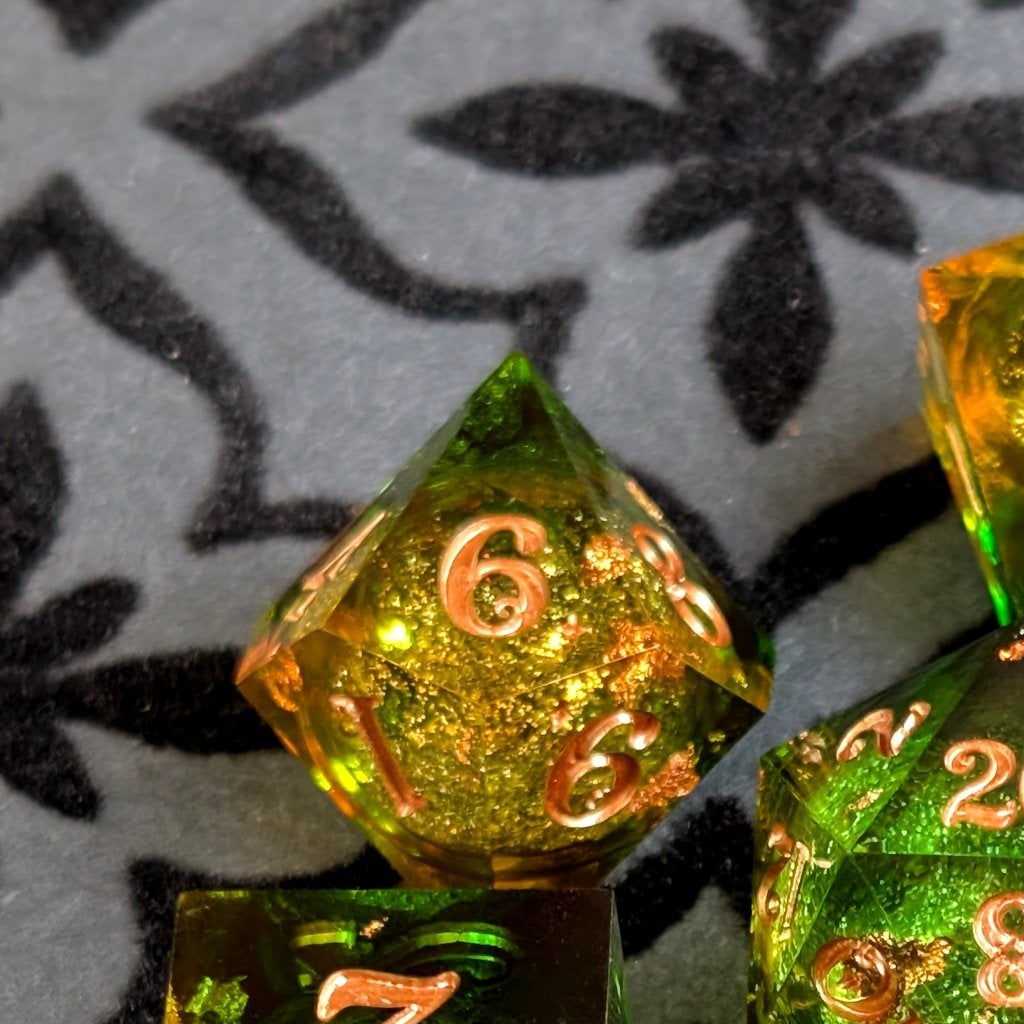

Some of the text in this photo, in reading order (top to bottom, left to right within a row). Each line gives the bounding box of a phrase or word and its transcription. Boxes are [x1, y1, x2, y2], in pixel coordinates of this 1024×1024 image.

[439, 514, 548, 638] 6
[630, 523, 733, 647] 8
[836, 701, 931, 762] 2
